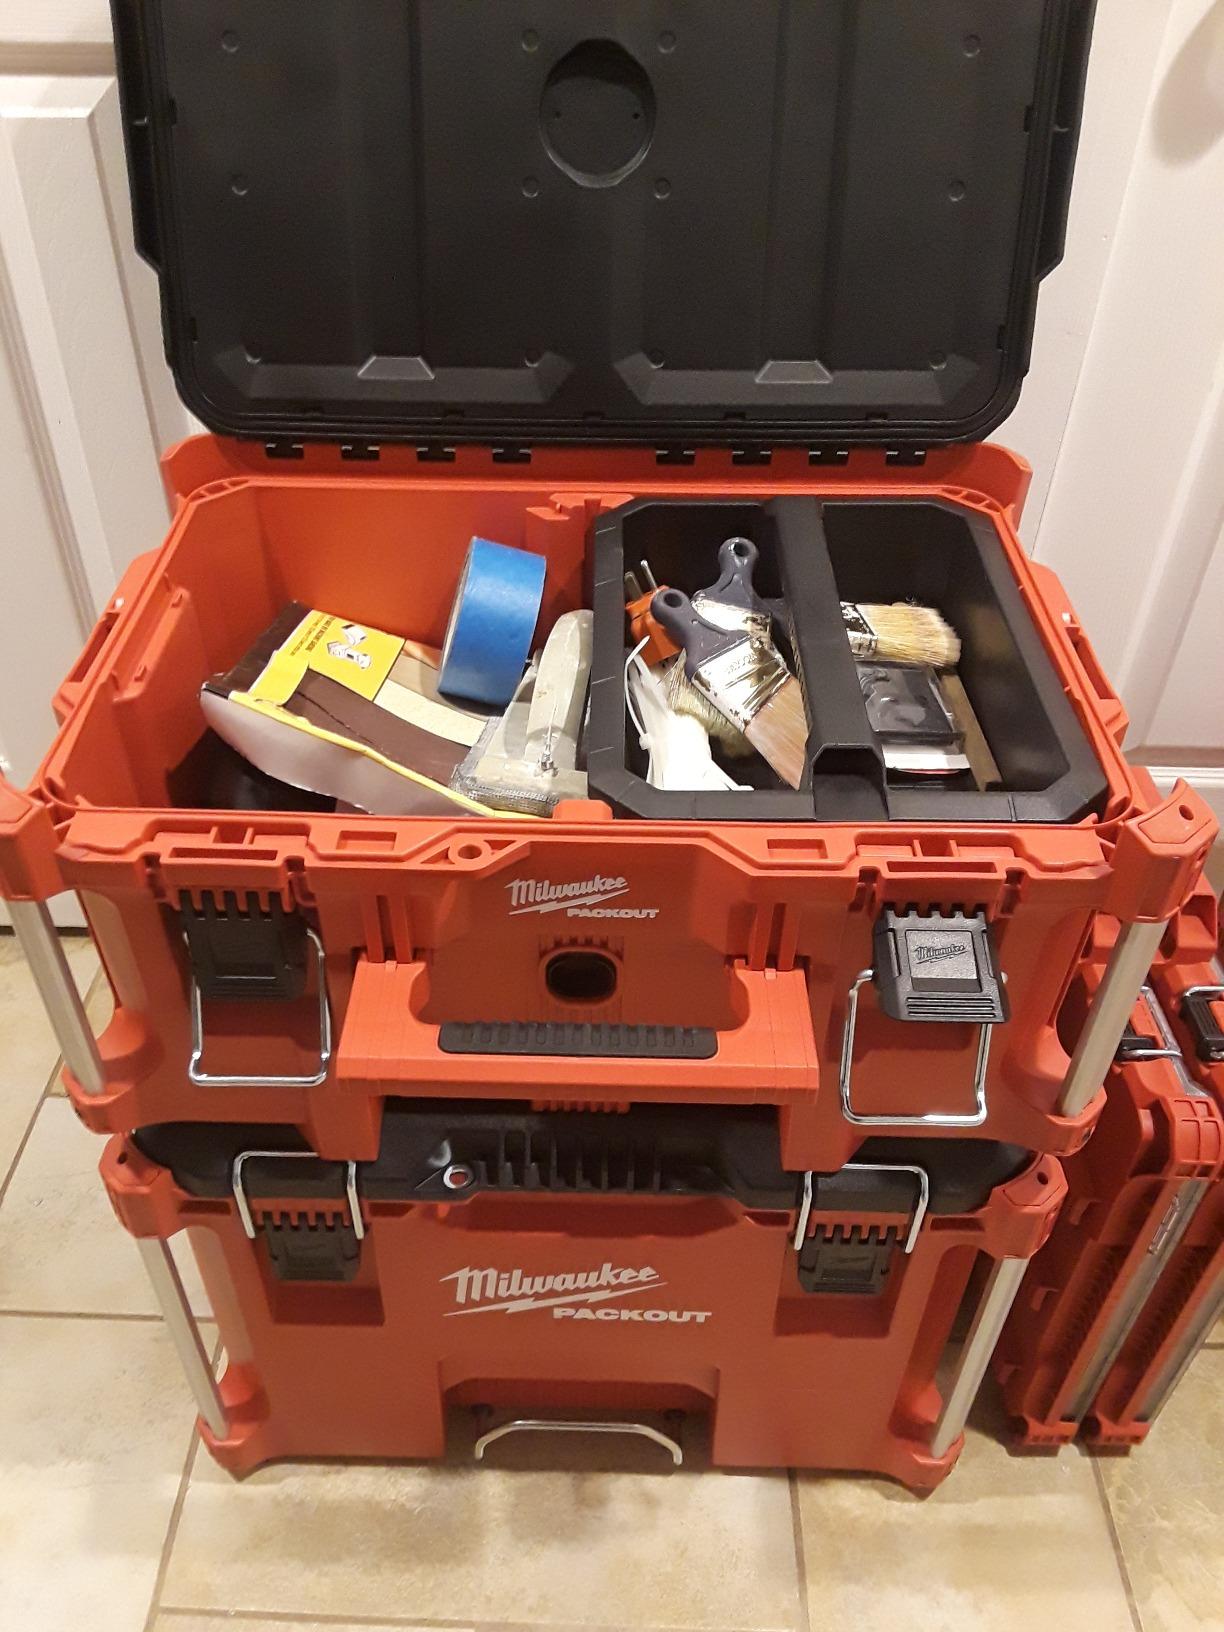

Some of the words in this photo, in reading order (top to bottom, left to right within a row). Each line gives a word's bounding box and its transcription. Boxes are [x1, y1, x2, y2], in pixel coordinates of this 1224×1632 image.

[504, 875, 629, 907] Milwaukee
[566, 908, 660, 919] PACKOUT
[439, 1262, 661, 1304] Milwaukee
[552, 1307, 713, 1323] PACKOUT
